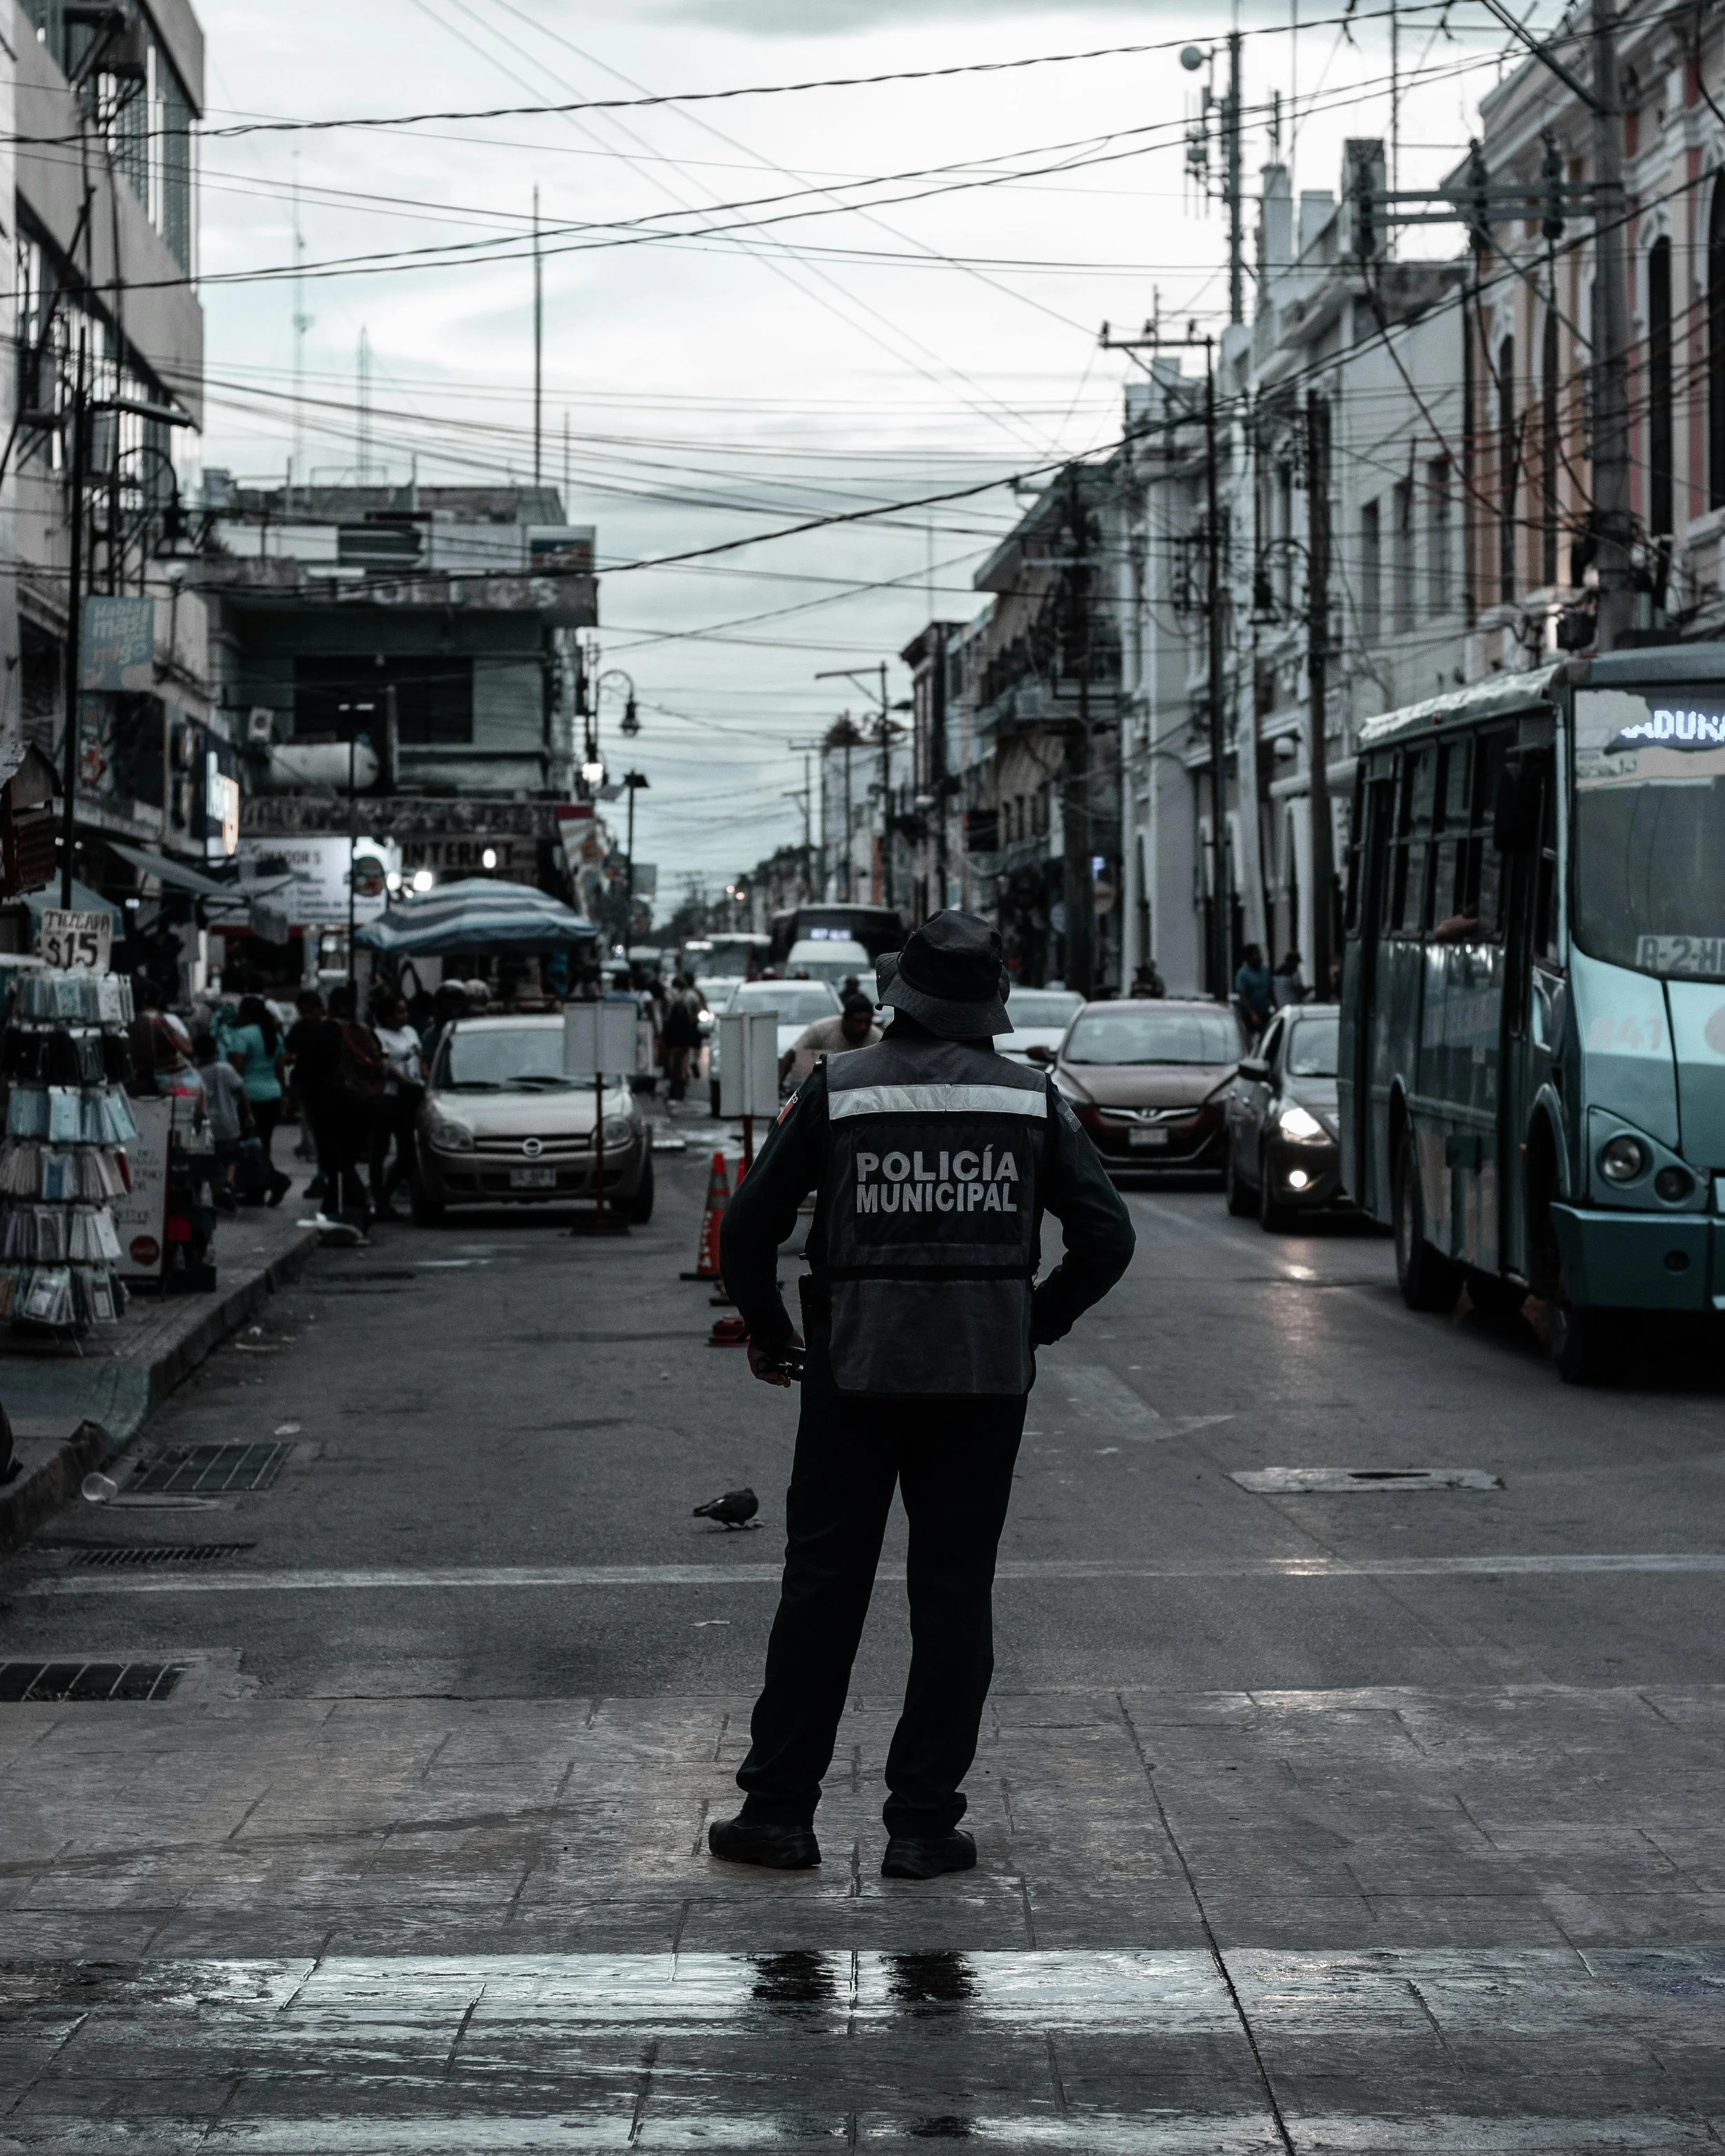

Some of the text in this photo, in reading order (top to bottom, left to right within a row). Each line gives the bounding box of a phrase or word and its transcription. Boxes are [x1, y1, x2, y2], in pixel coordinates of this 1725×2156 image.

[45, 931, 98, 969] $15
[1639, 937, 1725, 973] A-2-H
[1588, 1015, 1664, 1050] 841
[856, 1144, 1018, 1181] POLICÍA
[856, 1183, 1017, 1212] MUNICIPAL
